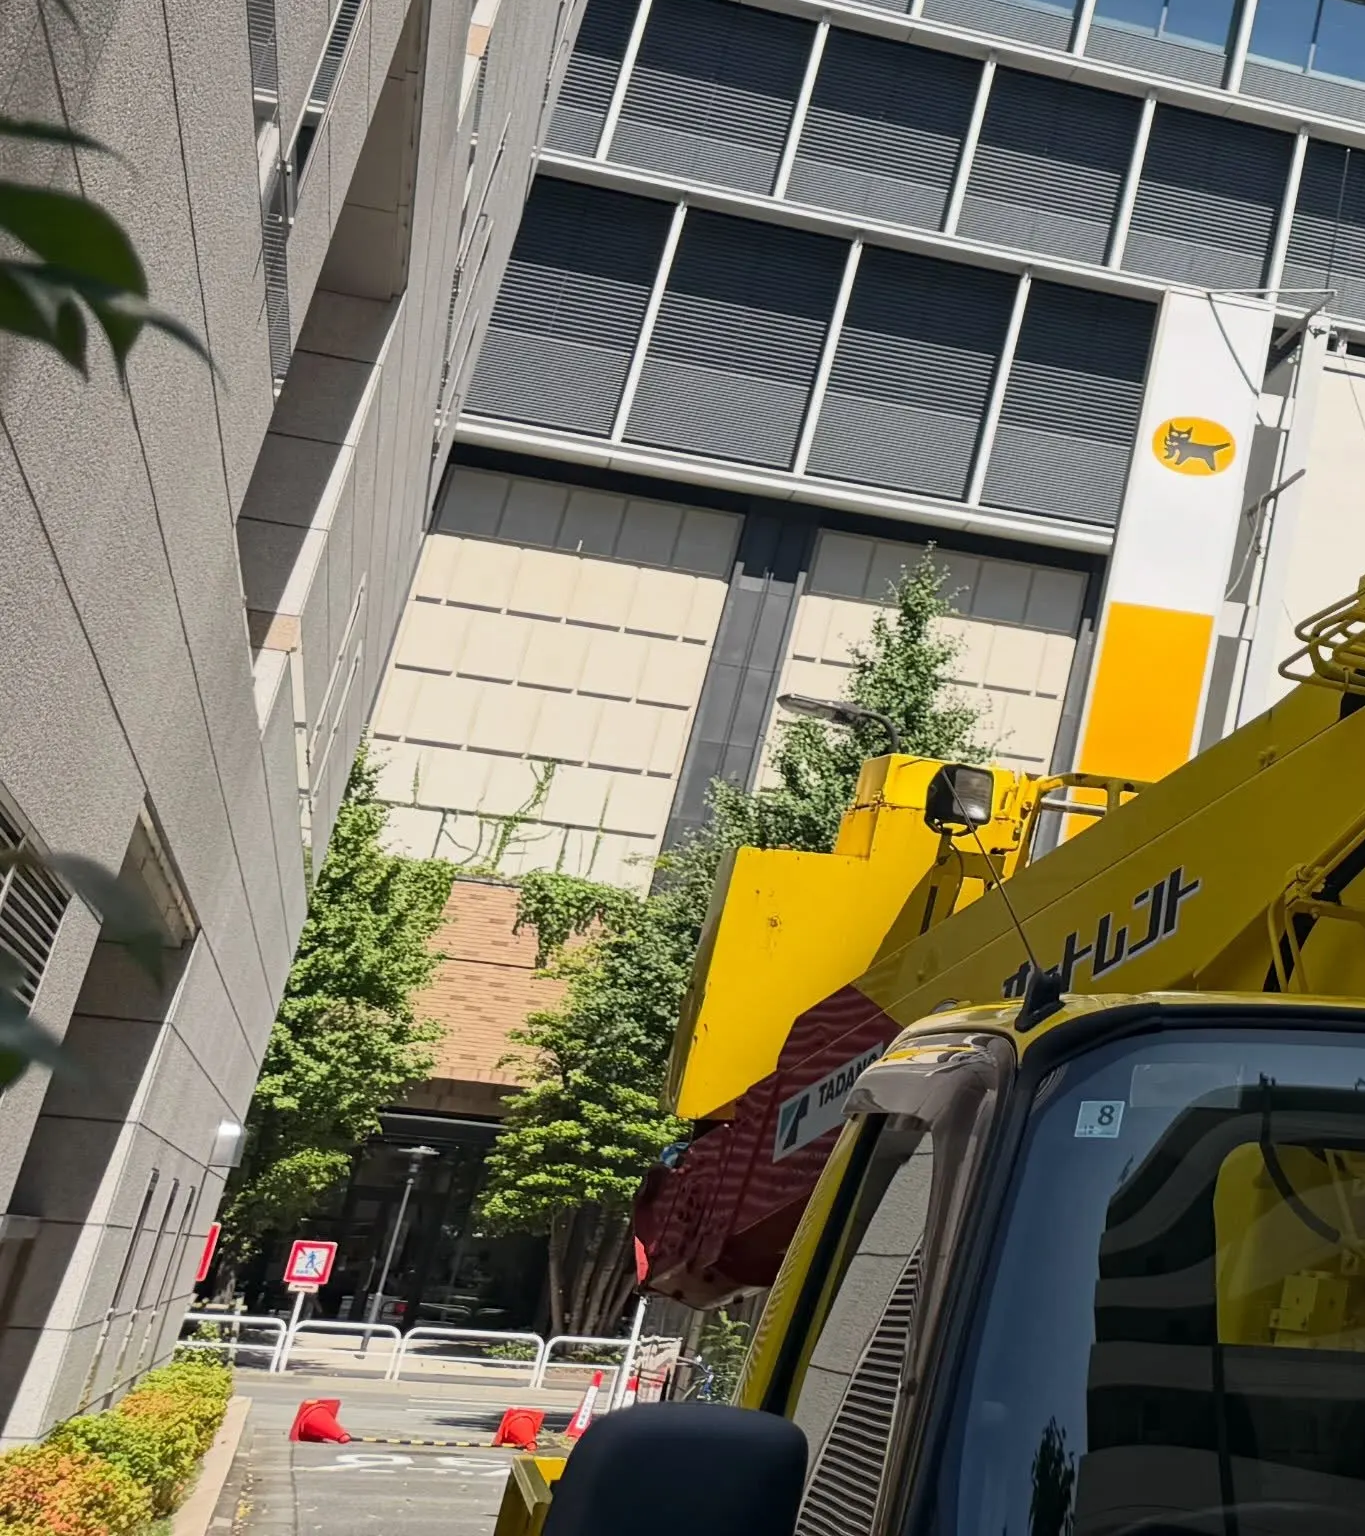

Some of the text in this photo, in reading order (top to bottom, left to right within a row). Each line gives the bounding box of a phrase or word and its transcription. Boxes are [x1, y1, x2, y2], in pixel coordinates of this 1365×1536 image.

[1003, 865, 1201, 999] トレント
[1097, 1104, 1115, 1126] 8
